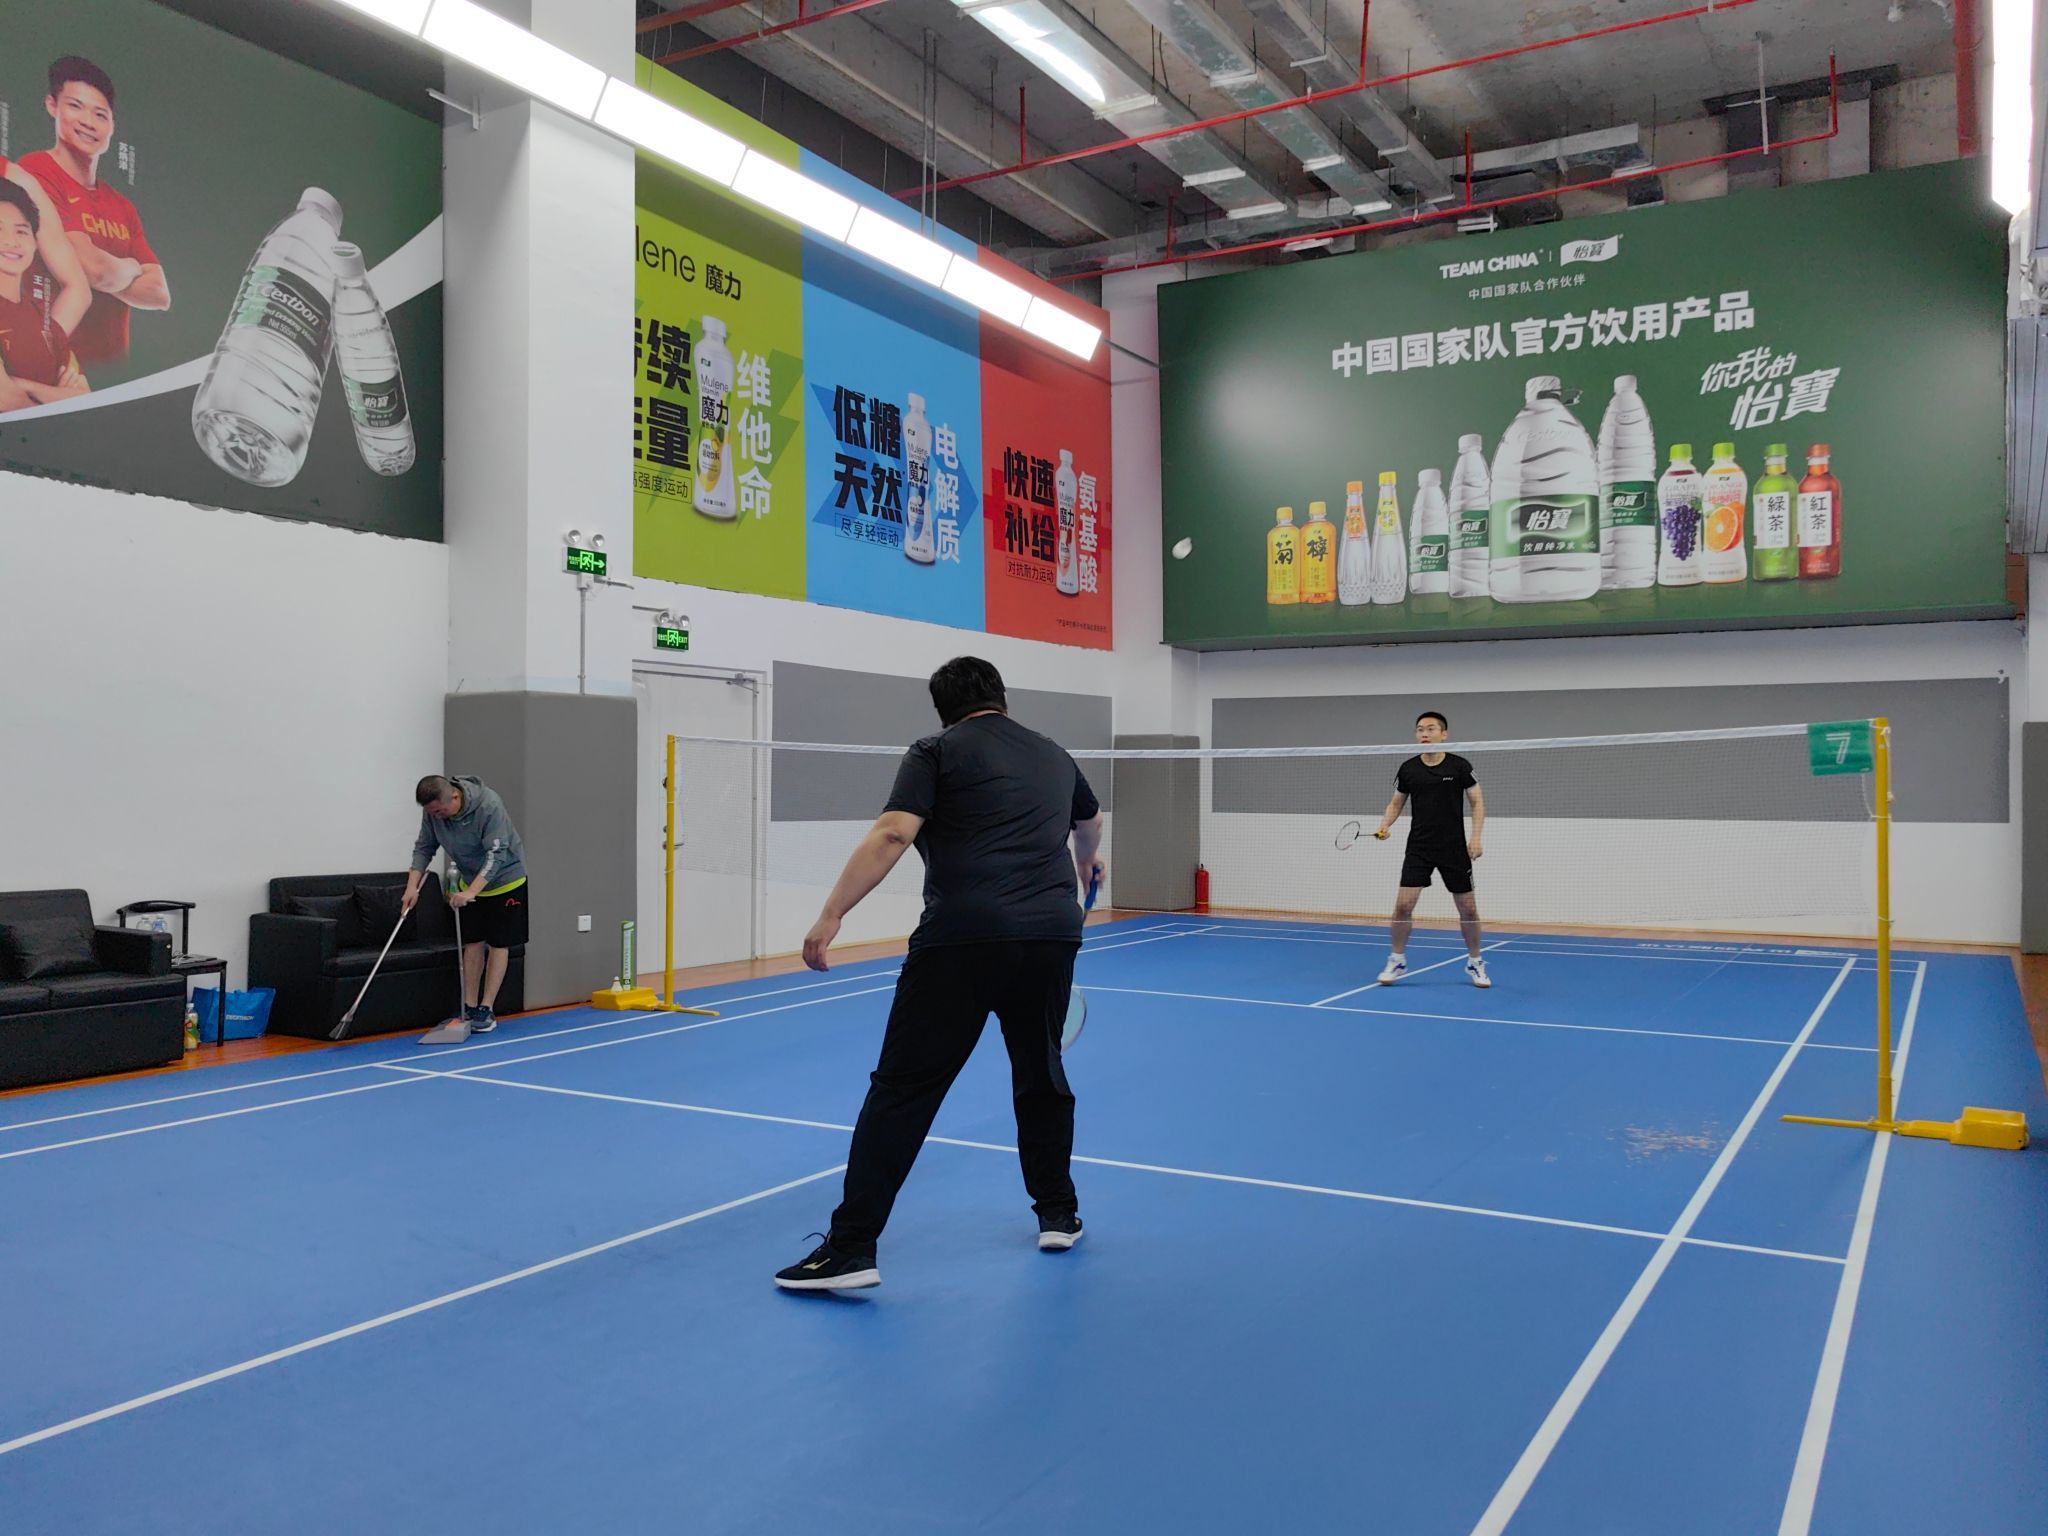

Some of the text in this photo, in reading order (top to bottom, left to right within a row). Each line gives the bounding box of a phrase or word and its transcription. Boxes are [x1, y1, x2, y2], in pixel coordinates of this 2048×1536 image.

[82, 212, 130, 240] CHINA
[706, 263, 742, 301] 魔力
[1440, 252, 1539, 279] TEAM CHINA
[1468, 273, 1586, 300] 中国国家队合作伙伴
[634, 316, 691, 395] 续
[1332, 290, 1756, 378] 中国国家队官方饮用产品
[701, 373, 729, 393] Mulene
[1700, 346, 1797, 395] 你我的
[702, 396, 729, 425] 魔力
[833, 385, 901, 459] 低糖
[634, 396, 691, 471] 量
[736, 350, 773, 520] 维他命
[834, 451, 903, 524] 天然
[909, 460, 929, 485] 魔力
[934, 422, 960, 564] 电解质
[1003, 446, 1055, 508] 快速
[840, 517, 899, 548] 尽享轻运动
[1004, 504, 1055, 563] 补给
[1060, 507, 1075, 527] 魔力
[1078, 471, 1098, 594] 氨基酸
[1008, 560, 1054, 584] 对抗耐力运动
[1826, 732, 1850, 765] 7
